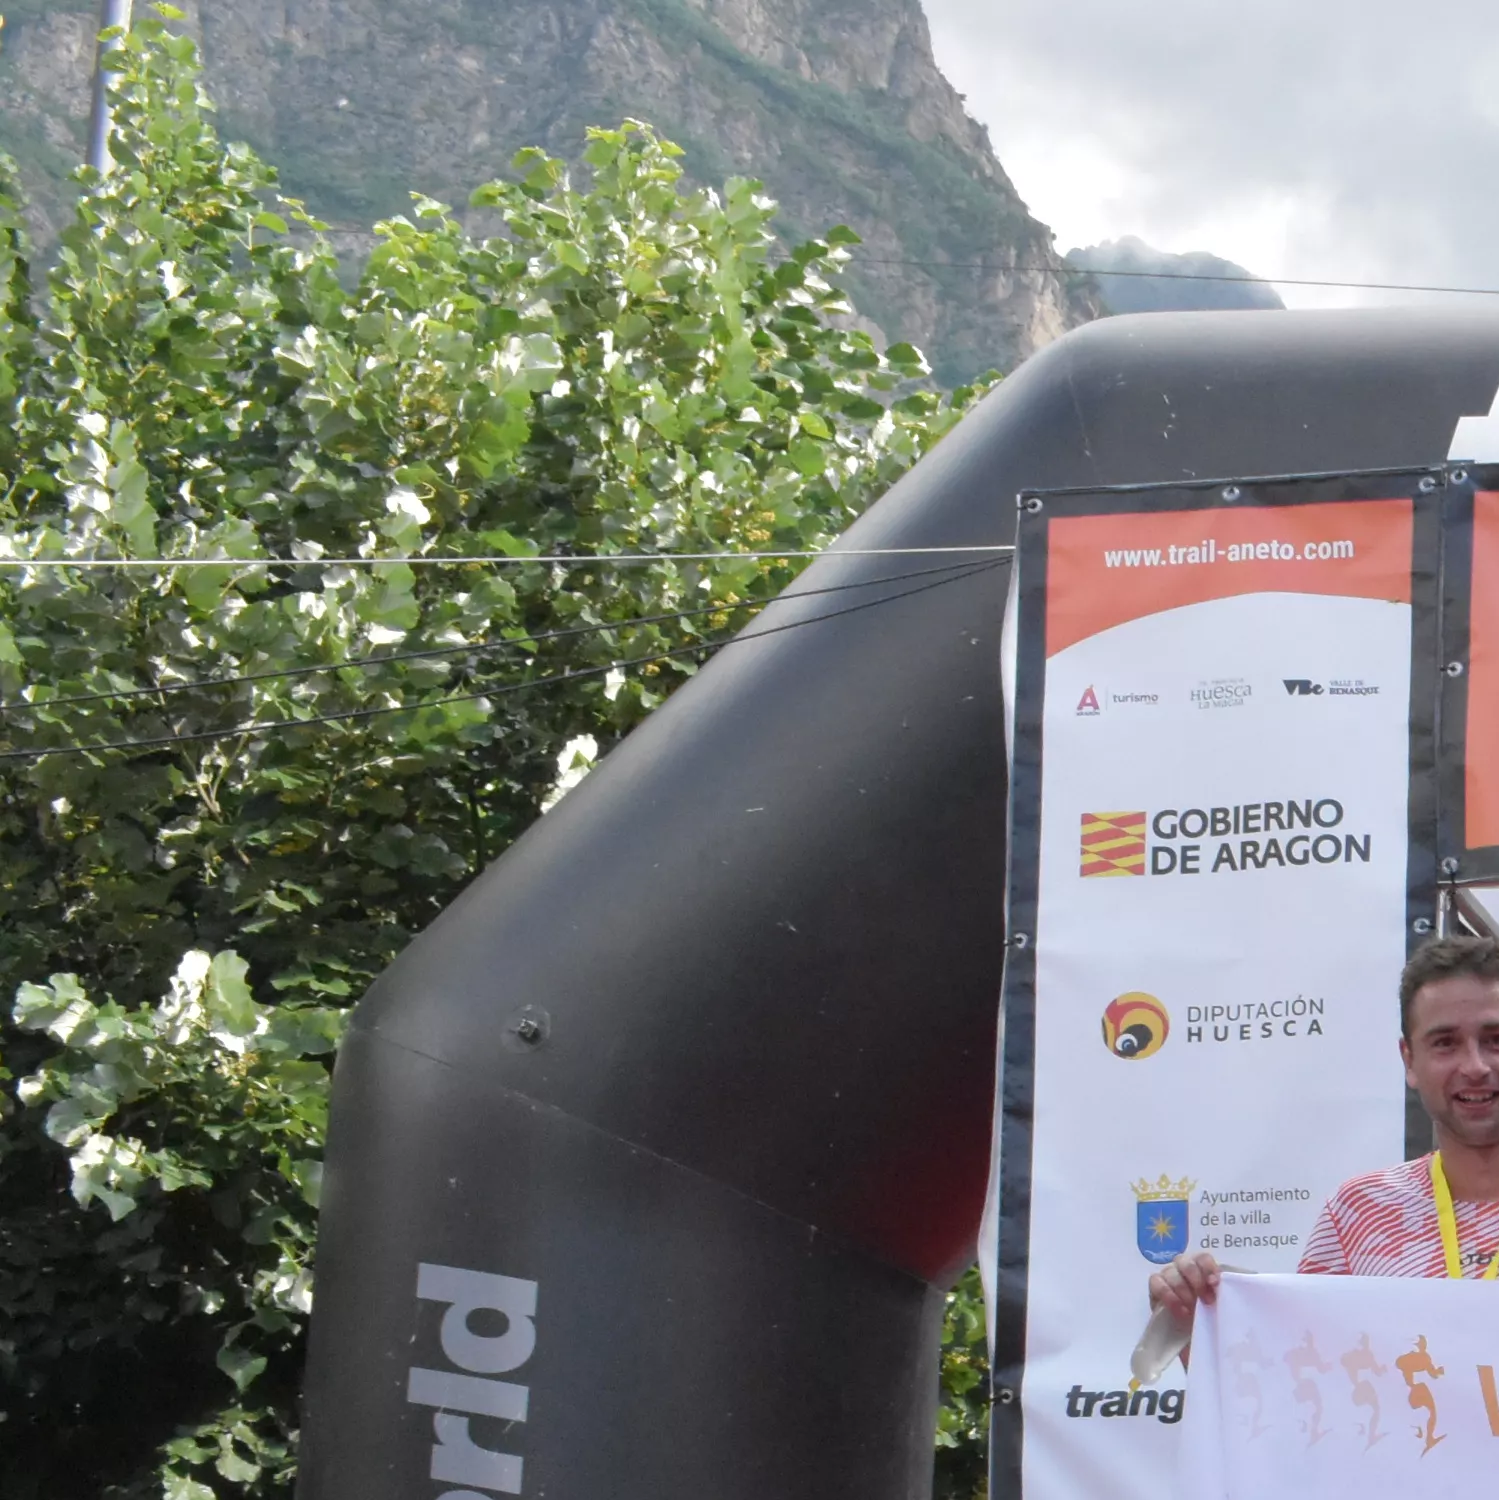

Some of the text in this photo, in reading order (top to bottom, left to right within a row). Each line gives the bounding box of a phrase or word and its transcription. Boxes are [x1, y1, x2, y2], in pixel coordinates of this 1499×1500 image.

[1104, 538, 1354, 568] www.trail-aneto.com
[1329, 686, 1380, 696] BENASQUE
[1152, 798, 1344, 838] GOBIERNO
[1152, 834, 1371, 875] DE ARAGON
[1187, 995, 1325, 1023] DIPUTACIÓN
[1187, 1019, 1324, 1043] HUESCA
[1200, 1187, 1311, 1204] Ayuntamiento
[1200, 1210, 1271, 1226] de la villa
[1200, 1232, 1299, 1250] de Benasque
